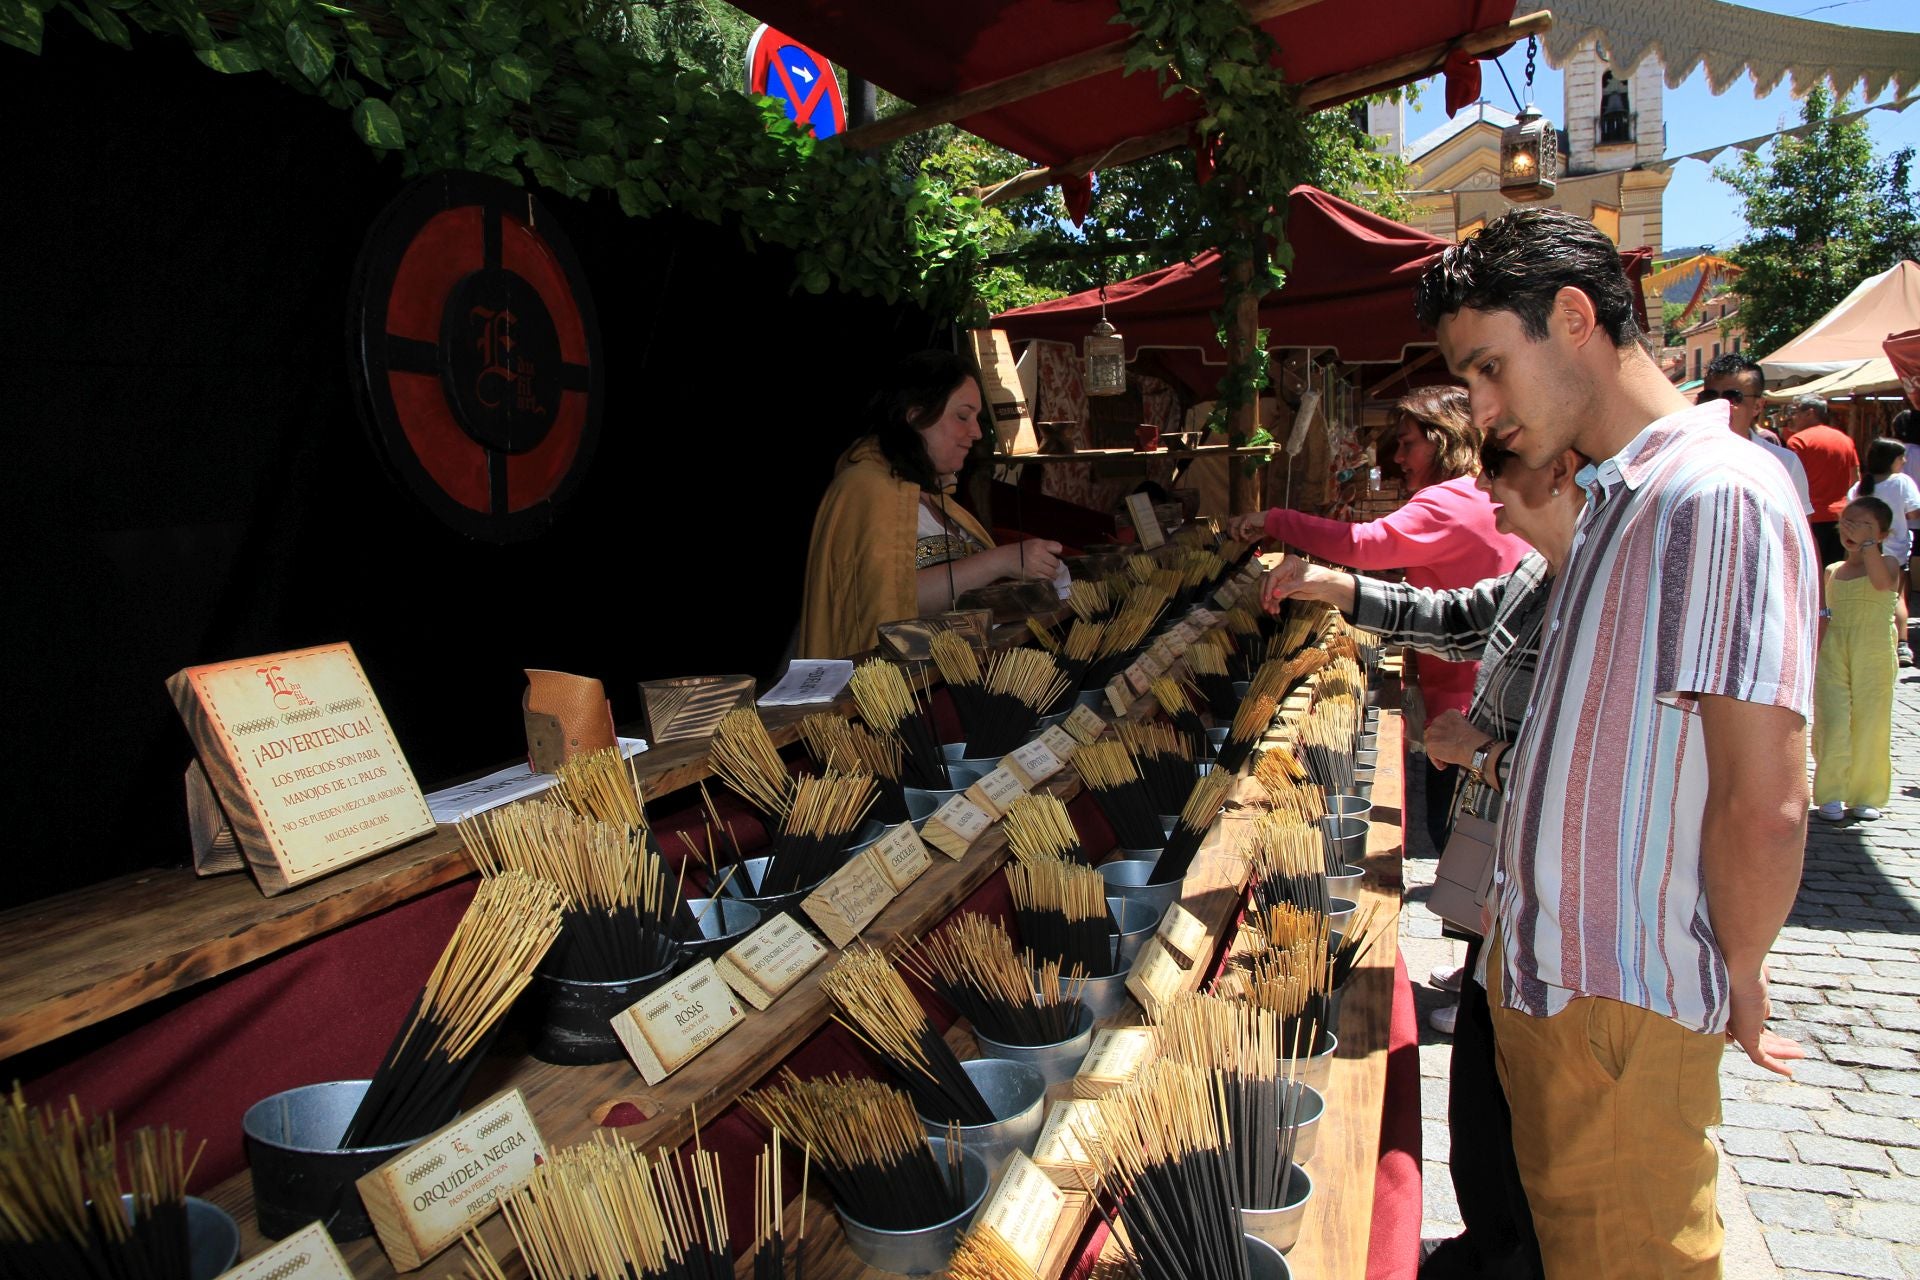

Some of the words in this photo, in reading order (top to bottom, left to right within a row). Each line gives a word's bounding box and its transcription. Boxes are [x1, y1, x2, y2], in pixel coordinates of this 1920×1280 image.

[252, 716, 373, 768] ¡ADVERTENCIA!
[272, 772, 294, 787] LOS
[294, 761, 337, 780] PRECIOS
[337, 755, 357, 769] SON
[357, 748, 380, 762] PARA
[282, 784, 331, 806] MANOJOS
[332, 778, 346, 791] DE
[347, 776, 359, 786] 12
[359, 766, 387, 782] PALOS
[282, 820, 297, 832] NO
[298, 816, 310, 827] SE
[310, 805, 341, 823] PUEDEN
[342, 795, 378, 813] MEZCLAR
[378, 785, 405, 800] AROMAS
[325, 824, 359, 843] MUCHAS
[360, 814, 390, 830] GRACIAS
[675, 1001, 704, 1026] ROSAS
[691, 1028, 709, 1045] PRECIO
[413, 1160, 484, 1212] ORQUÍDEA
[483, 1131, 526, 1165] NEGRA
[467, 1188, 497, 1214] PRECIO
